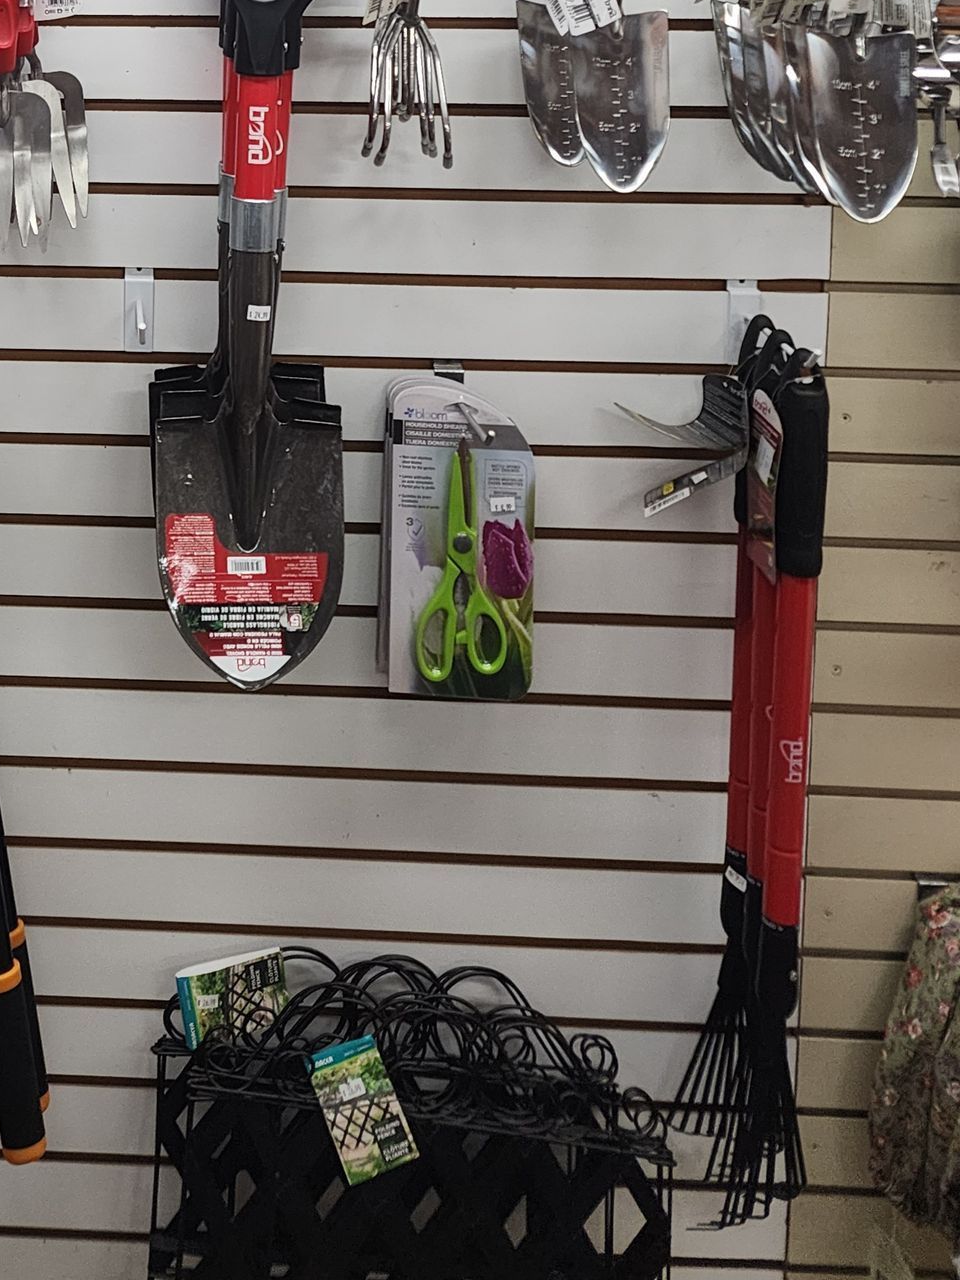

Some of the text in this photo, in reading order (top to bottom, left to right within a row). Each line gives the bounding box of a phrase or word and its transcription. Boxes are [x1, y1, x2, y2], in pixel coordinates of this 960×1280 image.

[248, 104, 270, 166] bond
[405, 430, 432, 438] CISAILLE
[406, 517, 414, 527] 3
[223, 621, 245, 629] HANDLE
[236, 657, 266, 672] bond
[779, 737, 805, 783] bond
